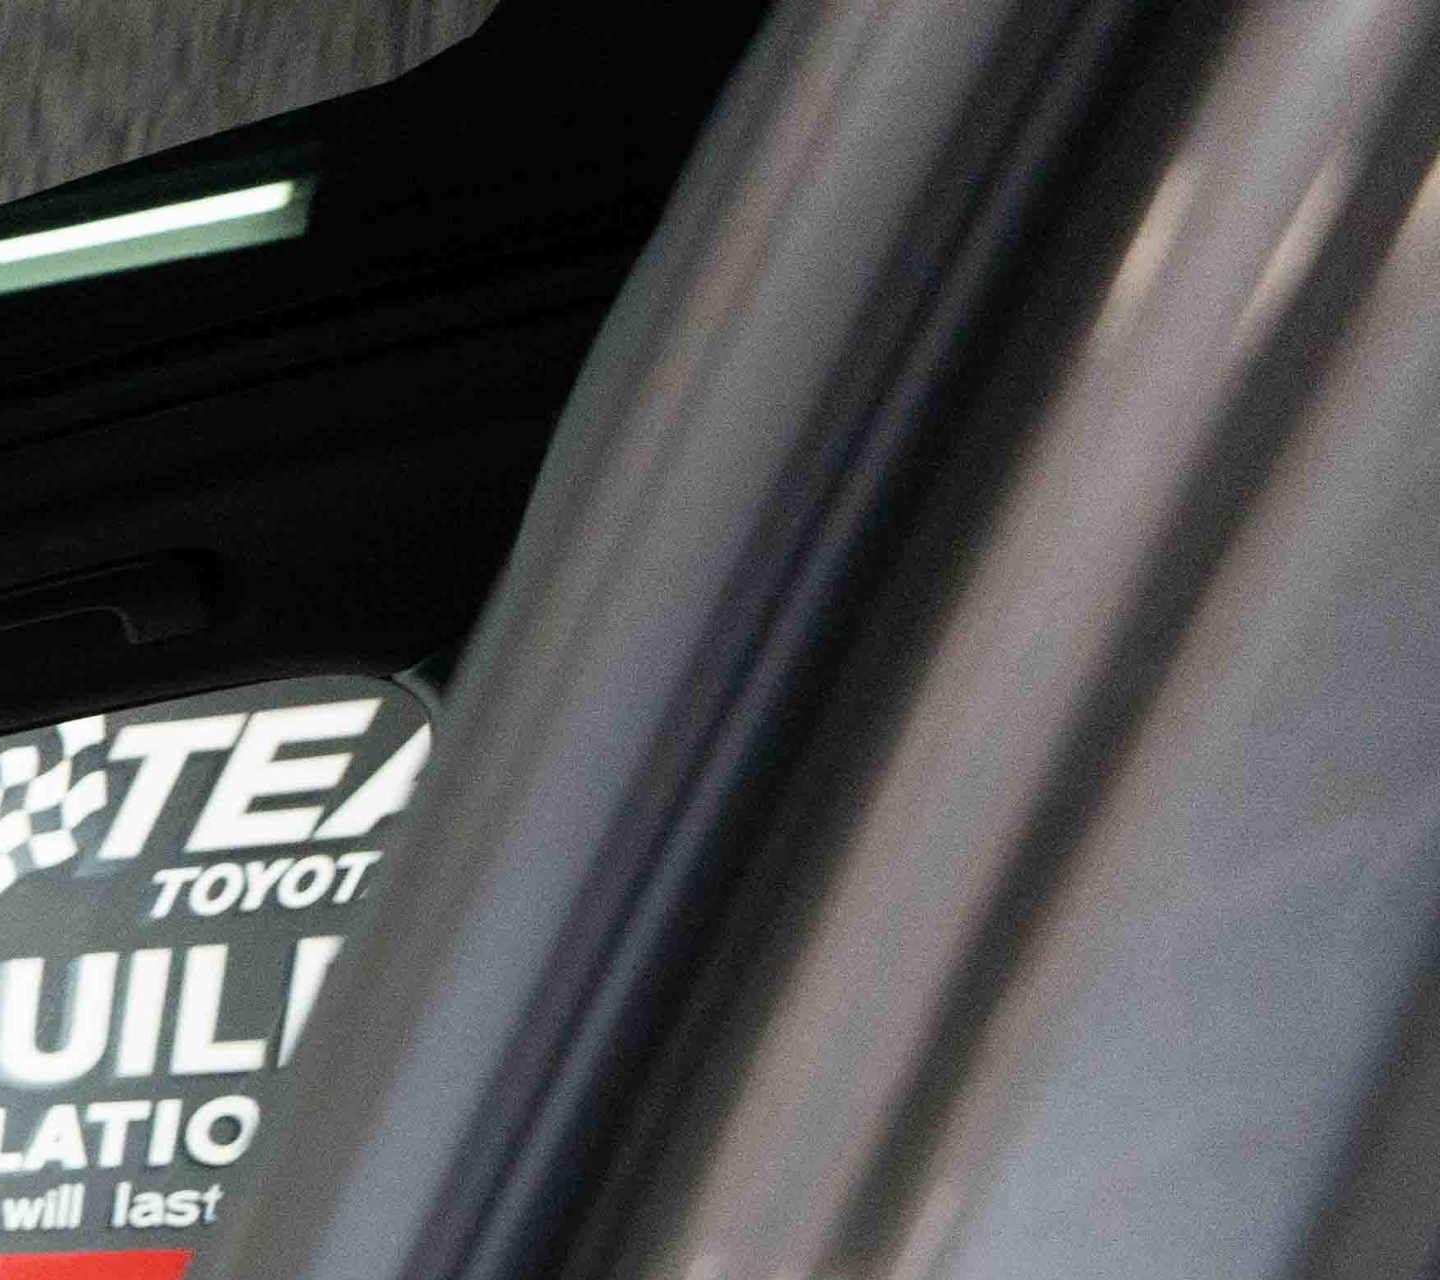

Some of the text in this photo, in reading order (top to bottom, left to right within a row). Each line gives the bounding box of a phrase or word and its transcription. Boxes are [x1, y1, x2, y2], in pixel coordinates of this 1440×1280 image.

[150, 850, 384, 919] TOYOT
[2, 1183, 84, 1231] will
[112, 1180, 223, 1229] last
